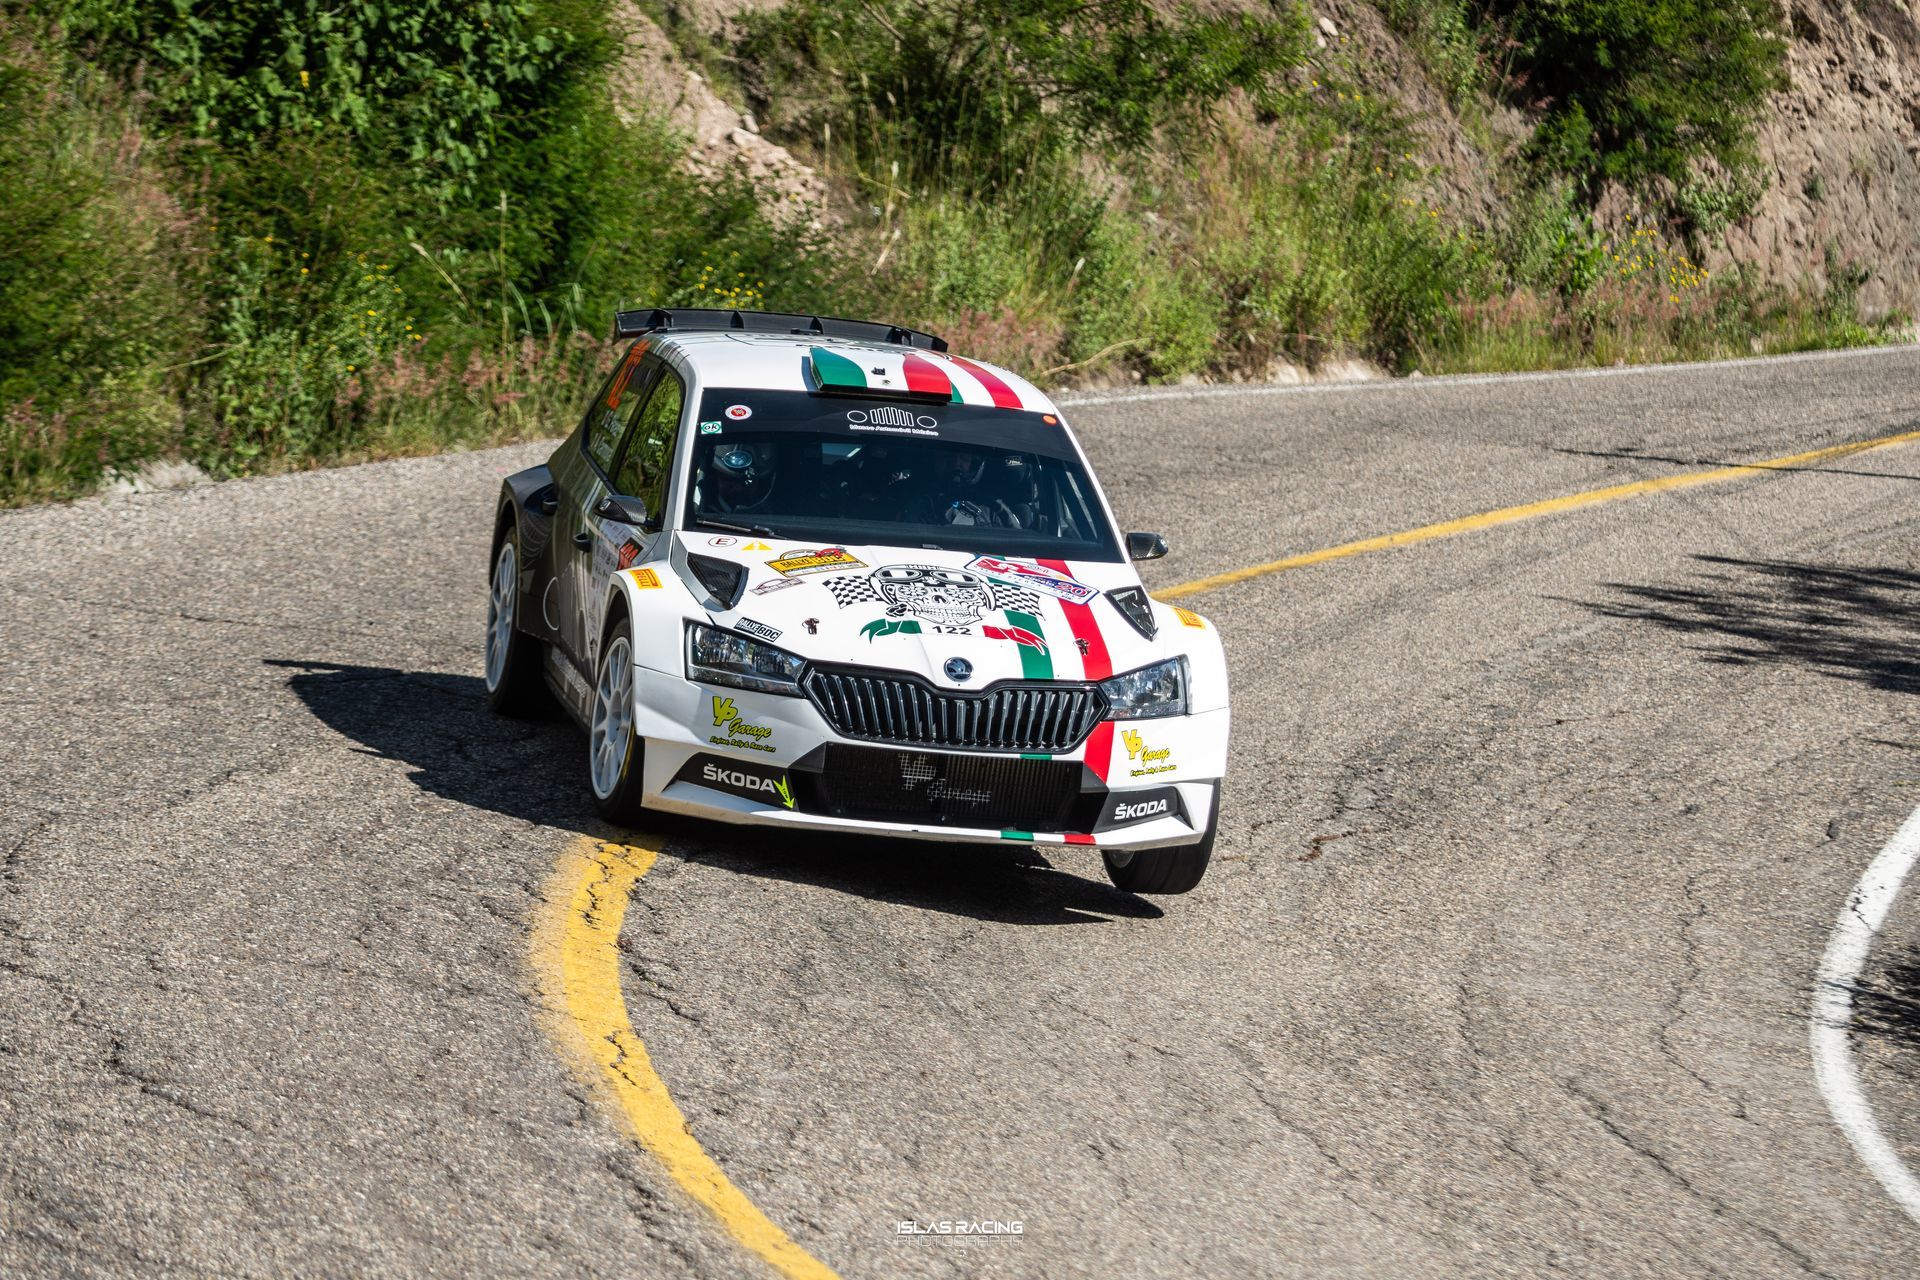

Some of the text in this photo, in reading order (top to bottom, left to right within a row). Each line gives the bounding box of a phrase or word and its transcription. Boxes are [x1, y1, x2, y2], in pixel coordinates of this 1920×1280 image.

[715, 537, 730, 545] E
[1055, 581, 1088, 597] 20
[757, 626, 779, 639] BDC
[932, 625, 972, 636] 122
[712, 696, 738, 727] VP
[728, 717, 772, 741] Garage
[1121, 729, 1143, 760] VP
[1141, 746, 1171, 767] Garage
[703, 762, 776, 793] ŠKODA
[1114, 799, 1167, 820] ŠKODA
